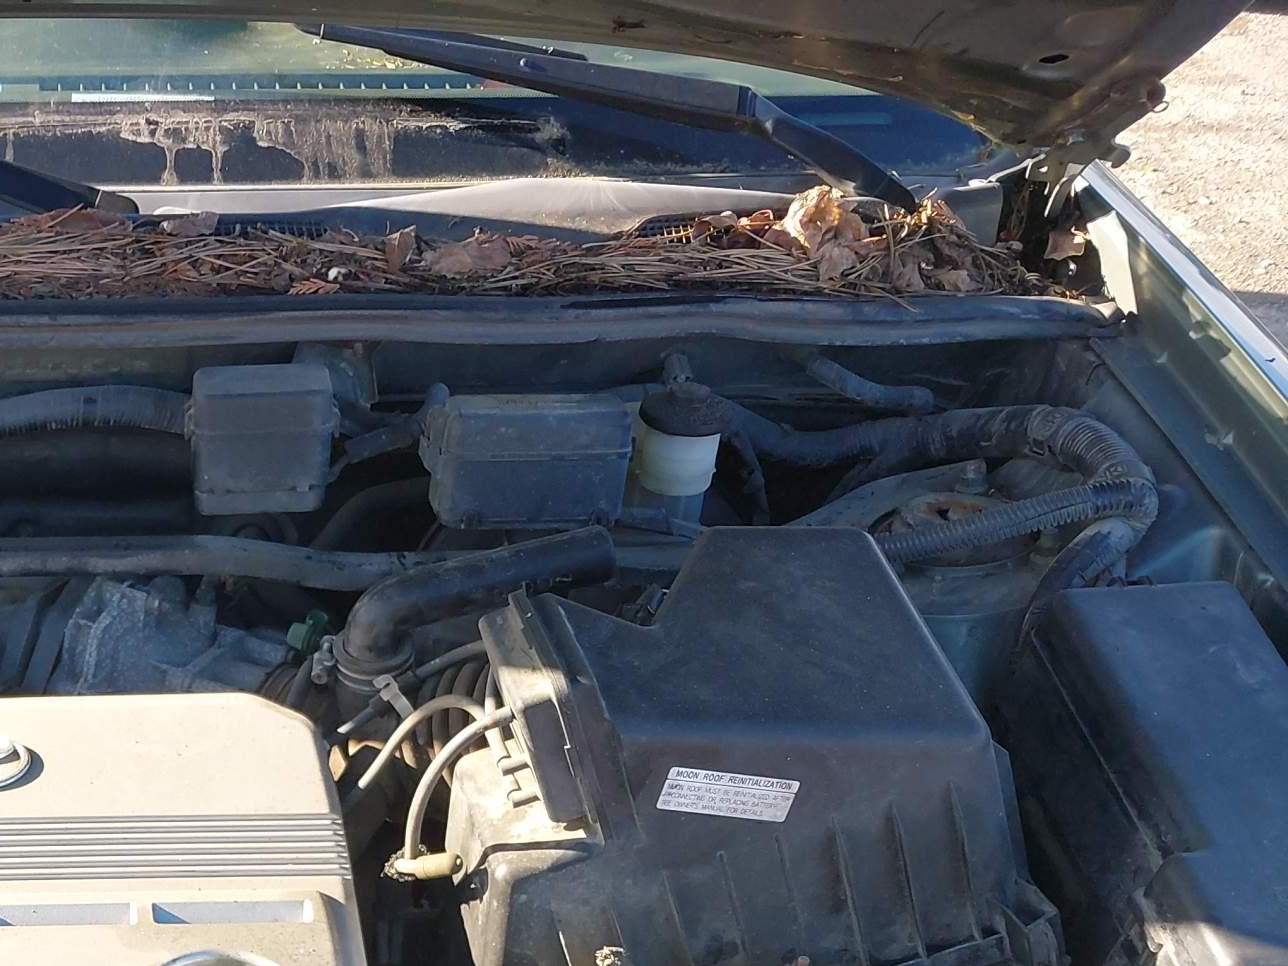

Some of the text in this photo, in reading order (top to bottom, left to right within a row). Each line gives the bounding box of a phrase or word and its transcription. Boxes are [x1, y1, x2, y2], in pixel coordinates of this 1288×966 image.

[675, 769, 794, 791] MOON ROOF REINITIALIZATION
